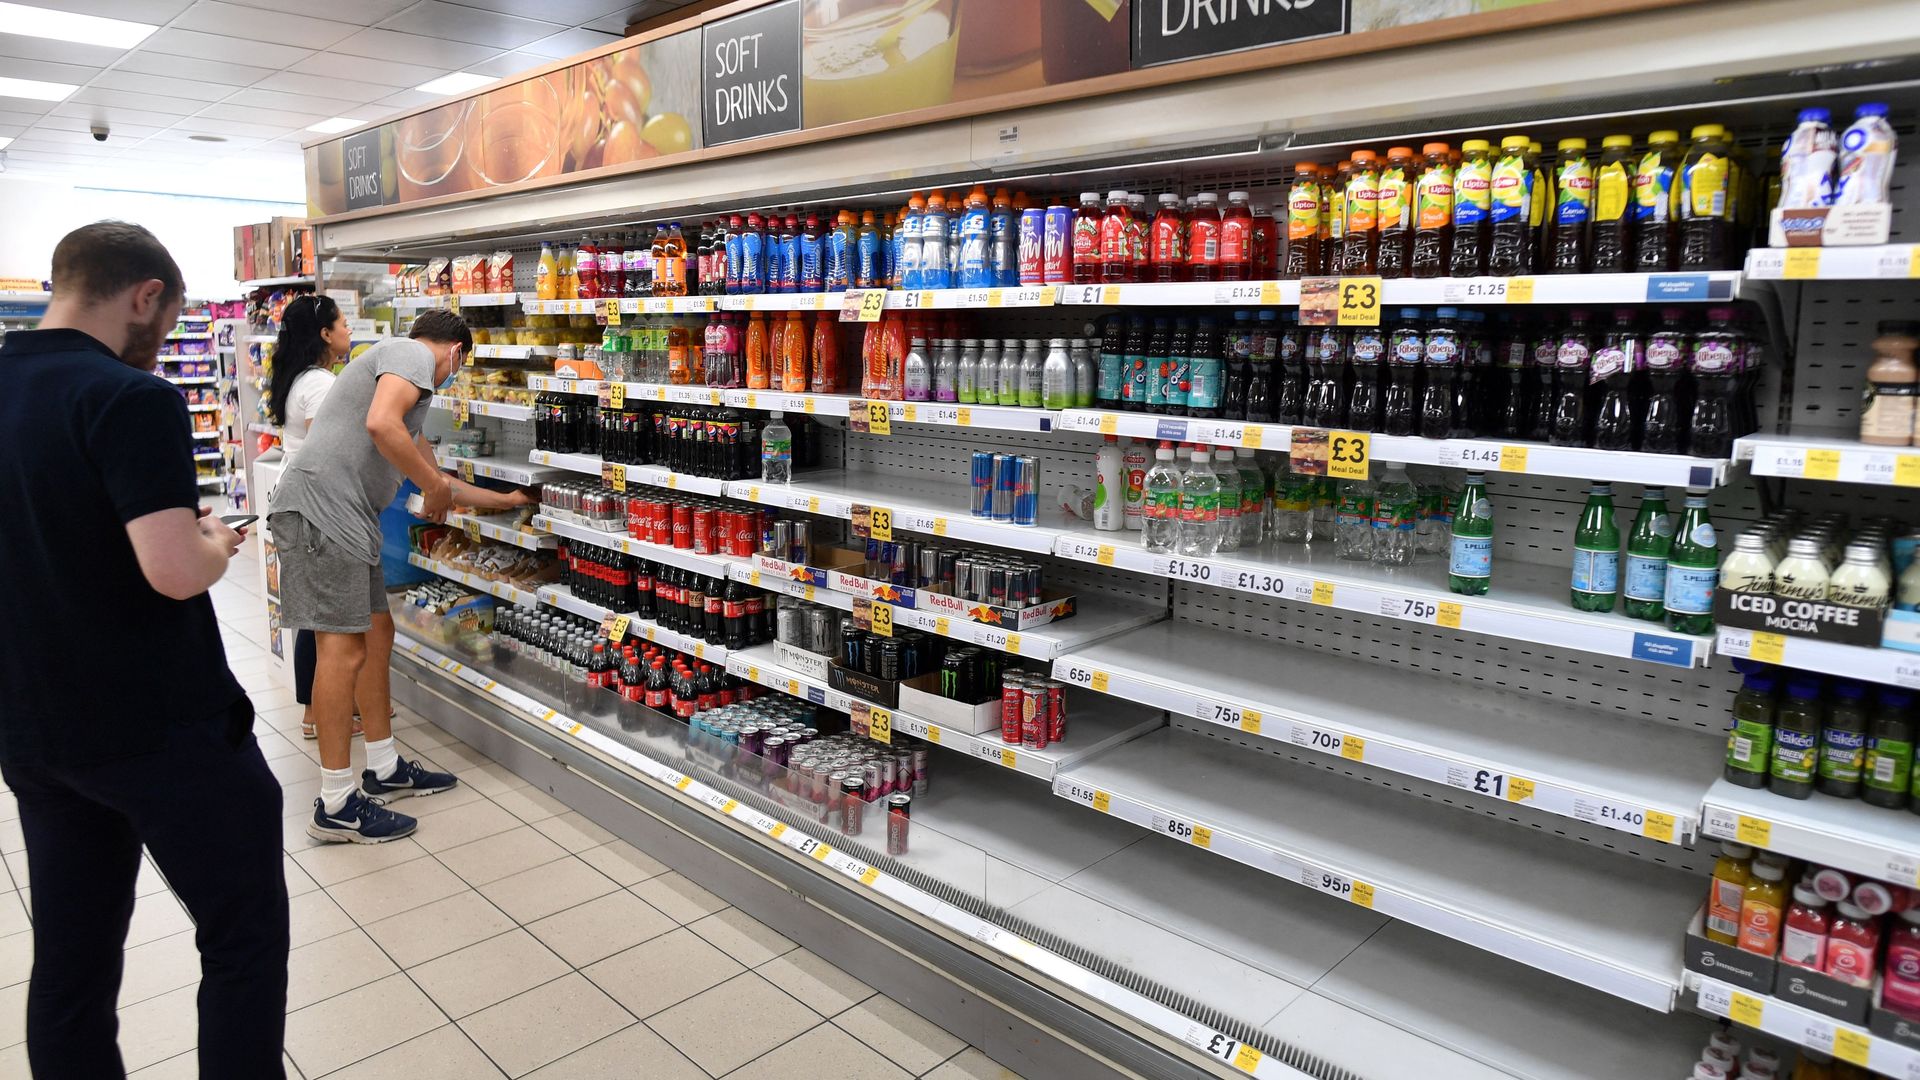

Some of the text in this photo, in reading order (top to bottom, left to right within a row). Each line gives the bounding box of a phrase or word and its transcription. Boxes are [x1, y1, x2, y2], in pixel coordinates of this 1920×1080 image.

[715, 33, 763, 79] SOFT
[715, 74, 788, 126] DRINKS
[348, 144, 366, 171] SOFT
[349, 171, 378, 201] DRINKS
[1430, 186, 1452, 194] Lipto
[1571, 179, 1592, 188] Lipto
[1357, 190, 1378, 199] Lipto
[1294, 201, 1315, 209] Lipton
[1456, 208, 1479, 217] Lemon
[1562, 207, 1586, 216] Lemon
[1019, 291, 1040, 301] £1.29
[1083, 287, 1102, 303] £1
[1232, 287, 1261, 298] £1.25
[1342, 284, 1376, 309] £3
[1468, 284, 1505, 295] £1.25
[863, 293, 881, 310] £3
[905, 292, 919, 307] £1
[968, 293, 988, 302] £1.50
[607, 301, 619, 316] £3
[1342, 313, 1376, 321] Meal Deal
[1356, 343, 1382, 351] Ribena
[1428, 343, 1454, 353] Ribena
[612, 385, 622, 400] £3
[870, 405, 887, 423] £3
[939, 411, 957, 420] £1.45
[1077, 416, 1100, 427] £1.40
[1214, 428, 1242, 440] £1.45
[1332, 437, 1364, 463] £3
[1462, 449, 1499, 462] £1.45
[614, 468, 624, 482] £3
[1331, 465, 1364, 475] Meal Deal
[1134, 476, 1141, 485] D
[872, 511, 889, 530] £3
[917, 519, 934, 529] £1.65
[1075, 544, 1098, 557] £1.25
[761, 558, 787, 572] Red Bull
[1168, 560, 1211, 580] £1.30
[790, 584, 805, 594] £1.20
[840, 575, 869, 590] Red Bull
[1238, 573, 1284, 594] £1.30
[1295, 586, 1312, 595] £1.30
[930, 595, 963, 612] Red Bull
[1404, 600, 1436, 618] 75p
[1730, 593, 1860, 627] ICED COFFEE
[873, 606, 889, 625] £3
[1022, 606, 1047, 620] Red Bull
[613, 619, 627, 633] £3
[919, 617, 935, 628] £1.10
[1765, 615, 1819, 634] MOCHA
[986, 634, 1006, 645] £1.20
[775, 678, 789, 688] £1.40
[1069, 668, 1091, 683] 65p
[846, 677, 880, 694] MONSTER
[872, 712, 889, 731] £3
[1214, 705, 1240, 725] 75p
[910, 723, 928, 735] £1.70
[1312, 731, 1340, 750] 70p
[1775, 728, 1814, 748] Naked
[1824, 729, 1863, 747] Naked
[982, 747, 1002, 759] £1.65
[1778, 748, 1806, 760] GREEN
[1828, 748, 1855, 760] GREEN
[1474, 770, 1504, 796] £1
[1071, 787, 1094, 802] £1.55
[1601, 805, 1643, 825] £1.40
[1168, 819, 1192, 838] 85p
[800, 838, 817, 854] £1
[846, 862, 866, 876] £1.10
[1322, 874, 1350, 895] 95p
[1715, 960, 1754, 978] innocent
[1805, 988, 1848, 1007] innocent
[1207, 1034, 1236, 1060] £1
